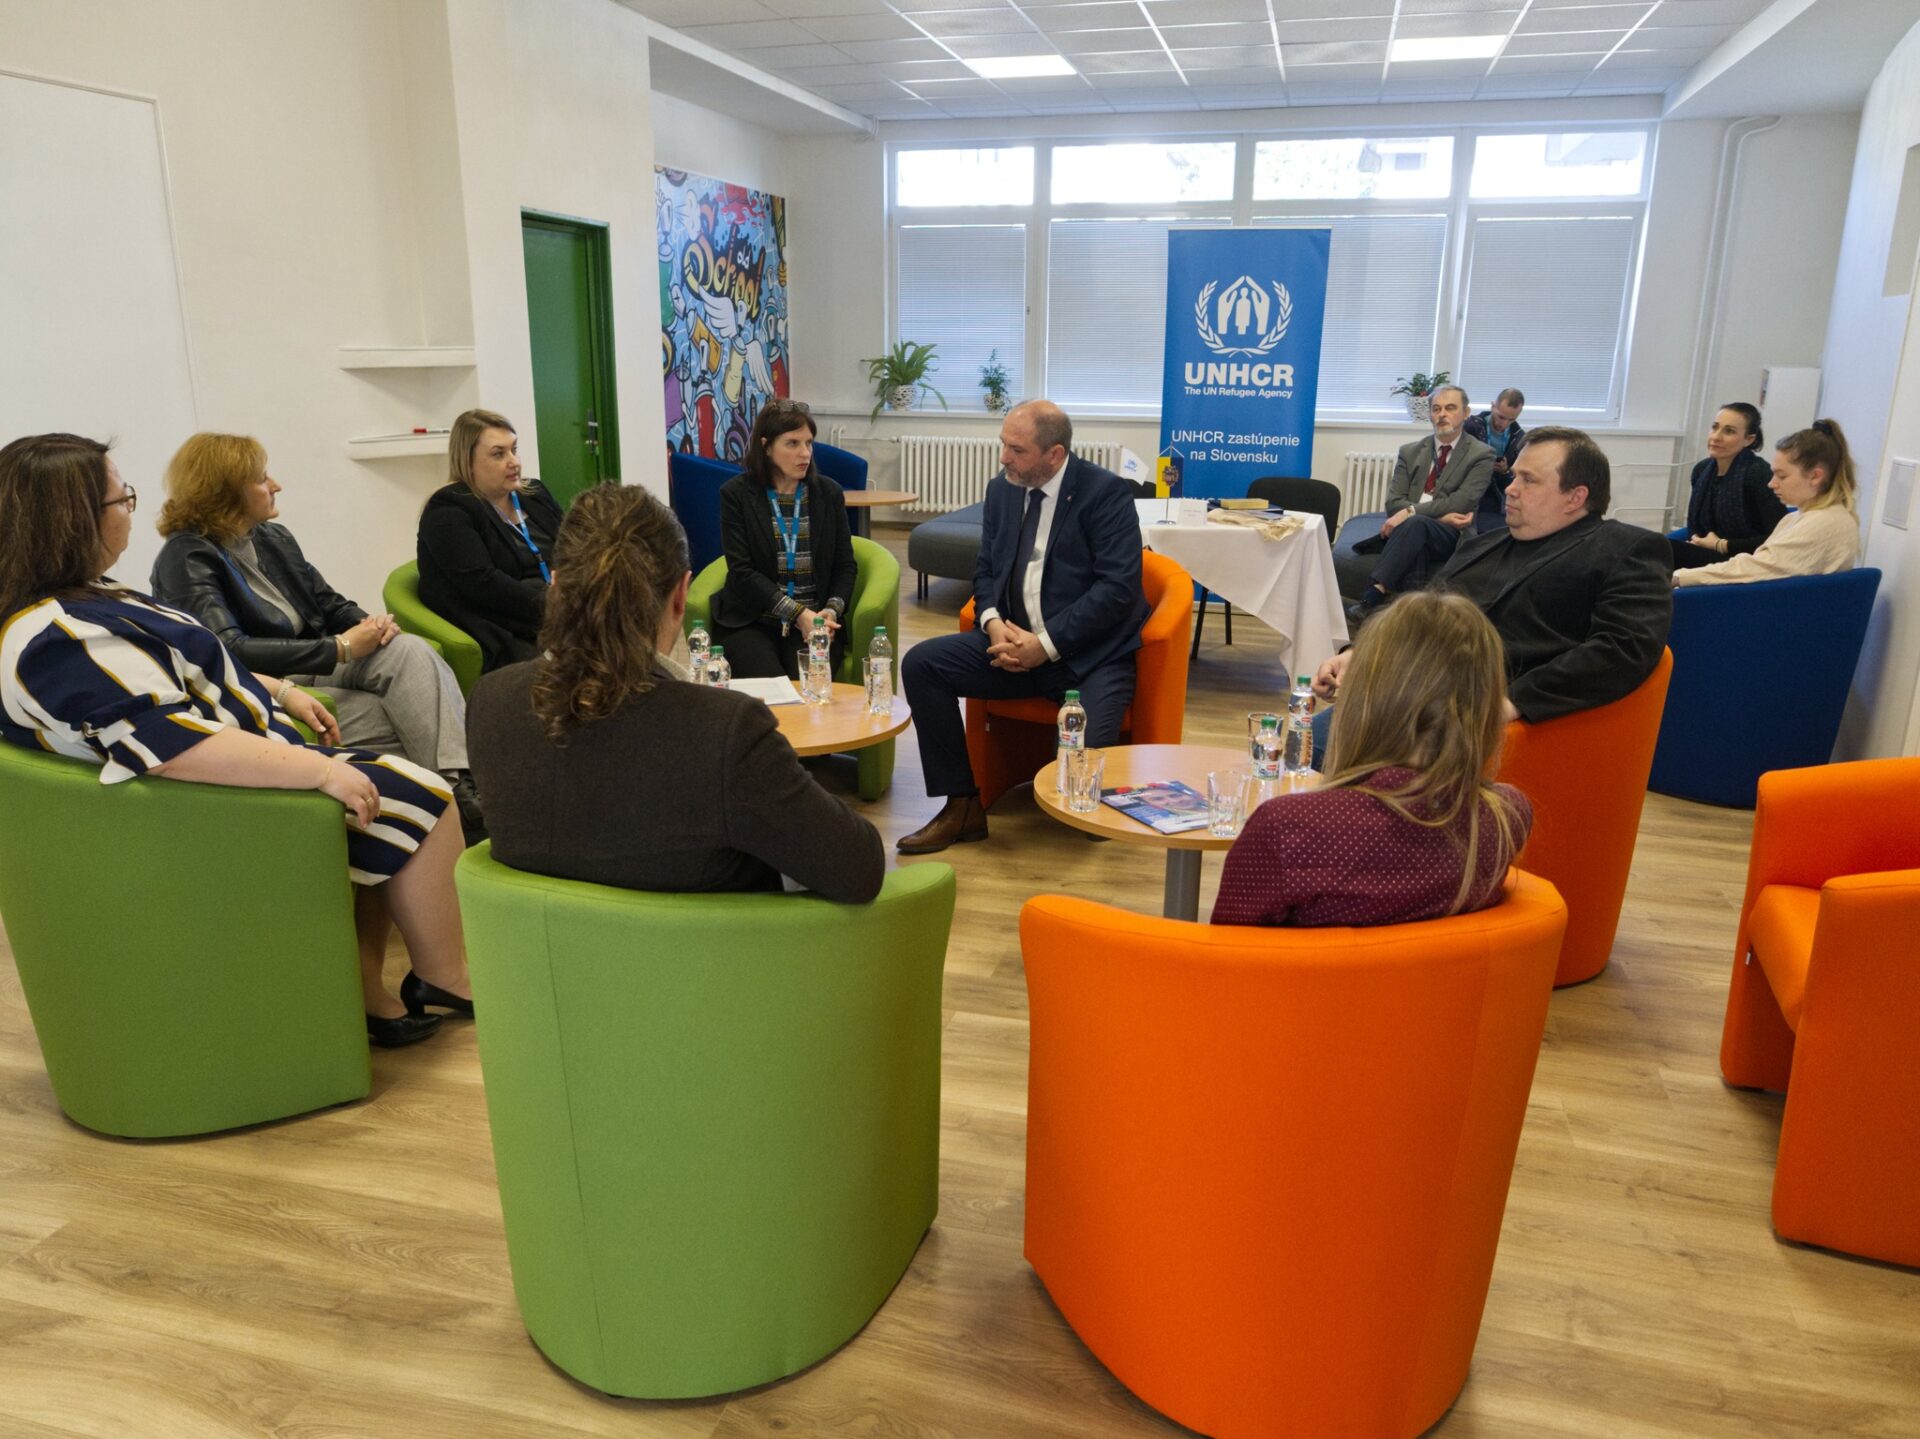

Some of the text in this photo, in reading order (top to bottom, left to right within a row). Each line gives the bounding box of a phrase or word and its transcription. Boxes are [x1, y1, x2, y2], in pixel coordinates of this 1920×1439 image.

[1184, 362, 1294, 387] UNHCR
[1184, 386, 1293, 398] The UN Refugee Agency
[1171, 430, 1300, 447] UNHCR zastúpenie
[1190, 449, 1278, 464] na Slovensku
